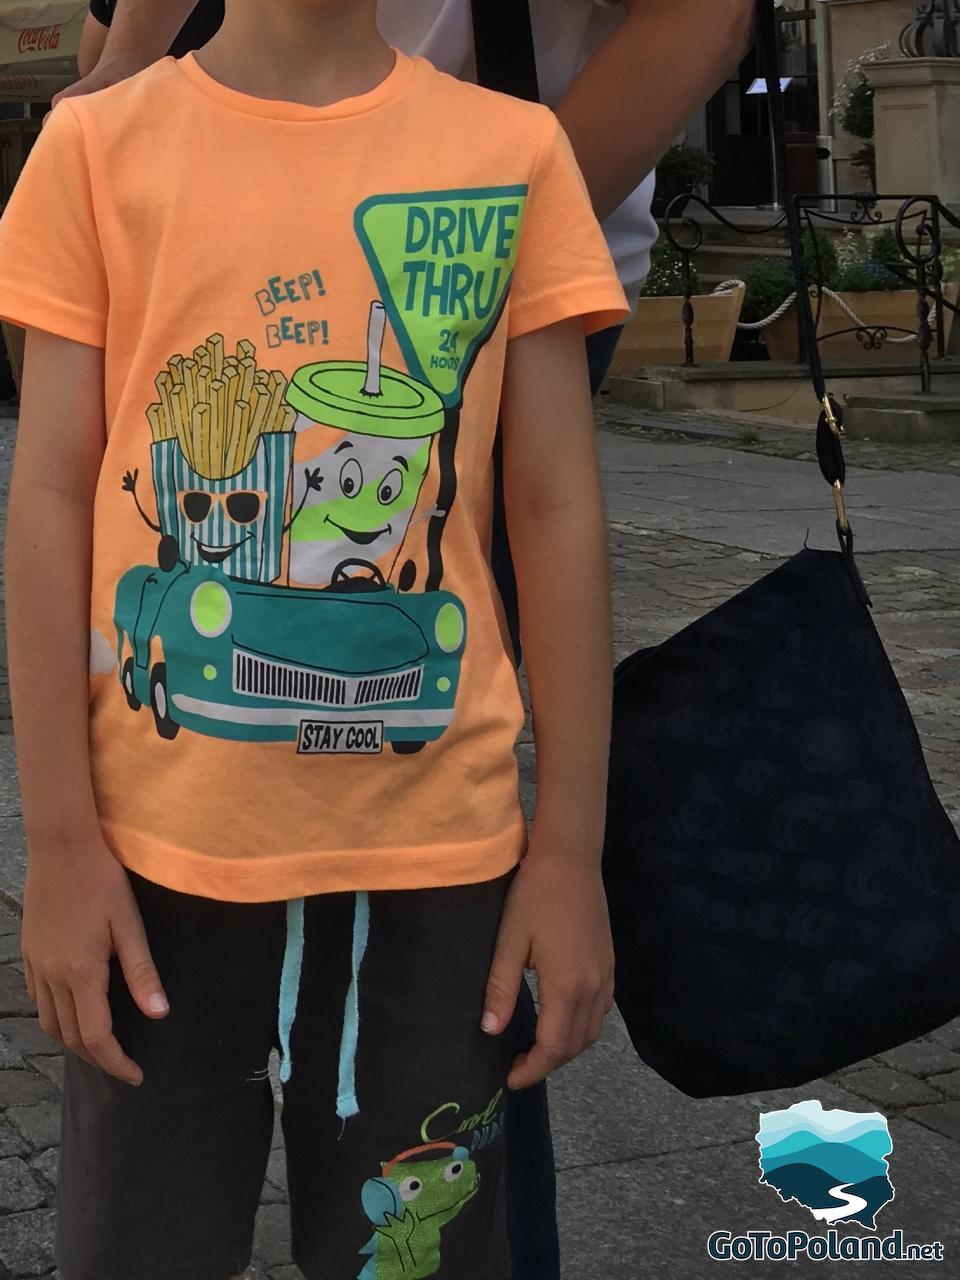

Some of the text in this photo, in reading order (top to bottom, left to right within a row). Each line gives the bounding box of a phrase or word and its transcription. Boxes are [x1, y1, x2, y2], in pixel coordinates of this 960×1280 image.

[404, 204, 519, 260] DRIVE
[254, 268, 326, 317] BEEP!
[403, 259, 503, 321] THRU
[266, 315, 329, 349] BEEP!
[438, 328, 460, 353] 24
[302, 723, 380, 750] STAY COOL
